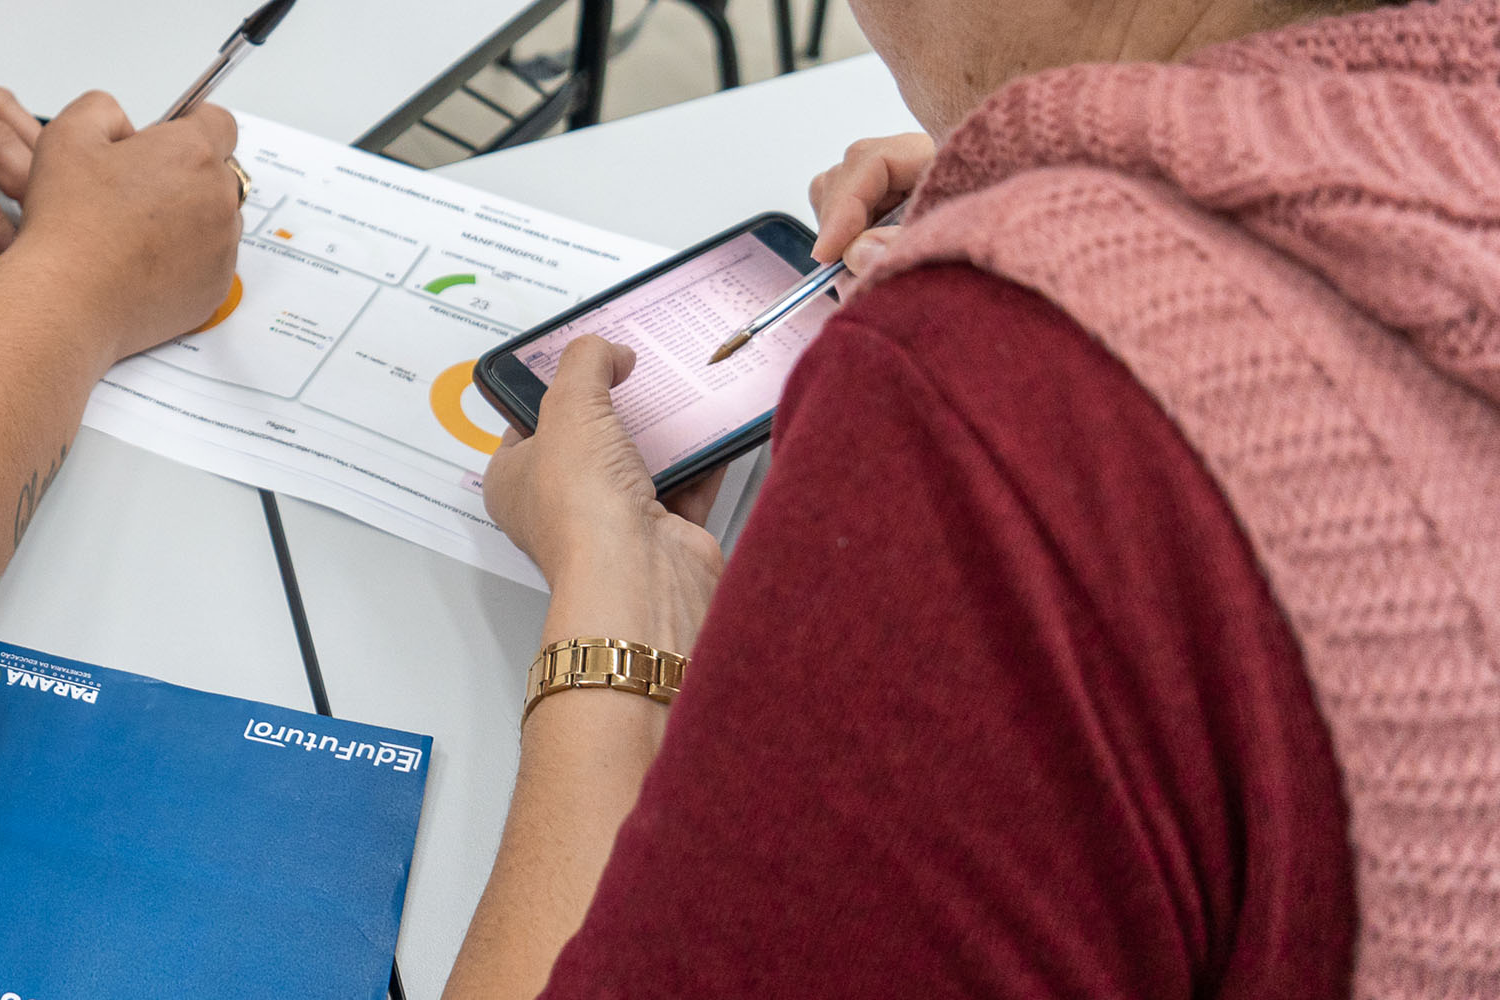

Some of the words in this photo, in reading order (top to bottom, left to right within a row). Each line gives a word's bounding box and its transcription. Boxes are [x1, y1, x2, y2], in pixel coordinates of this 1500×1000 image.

[469, 297, 491, 311] 23
[0, 651, 38, 665] EDUCAÇÃO
[50, 664, 92, 679] SECRETARIA
[6, 668, 99, 704] PARANÁ
[53, 672, 102, 688] GOVERNO
[252, 721, 418, 773] EduFuturo
